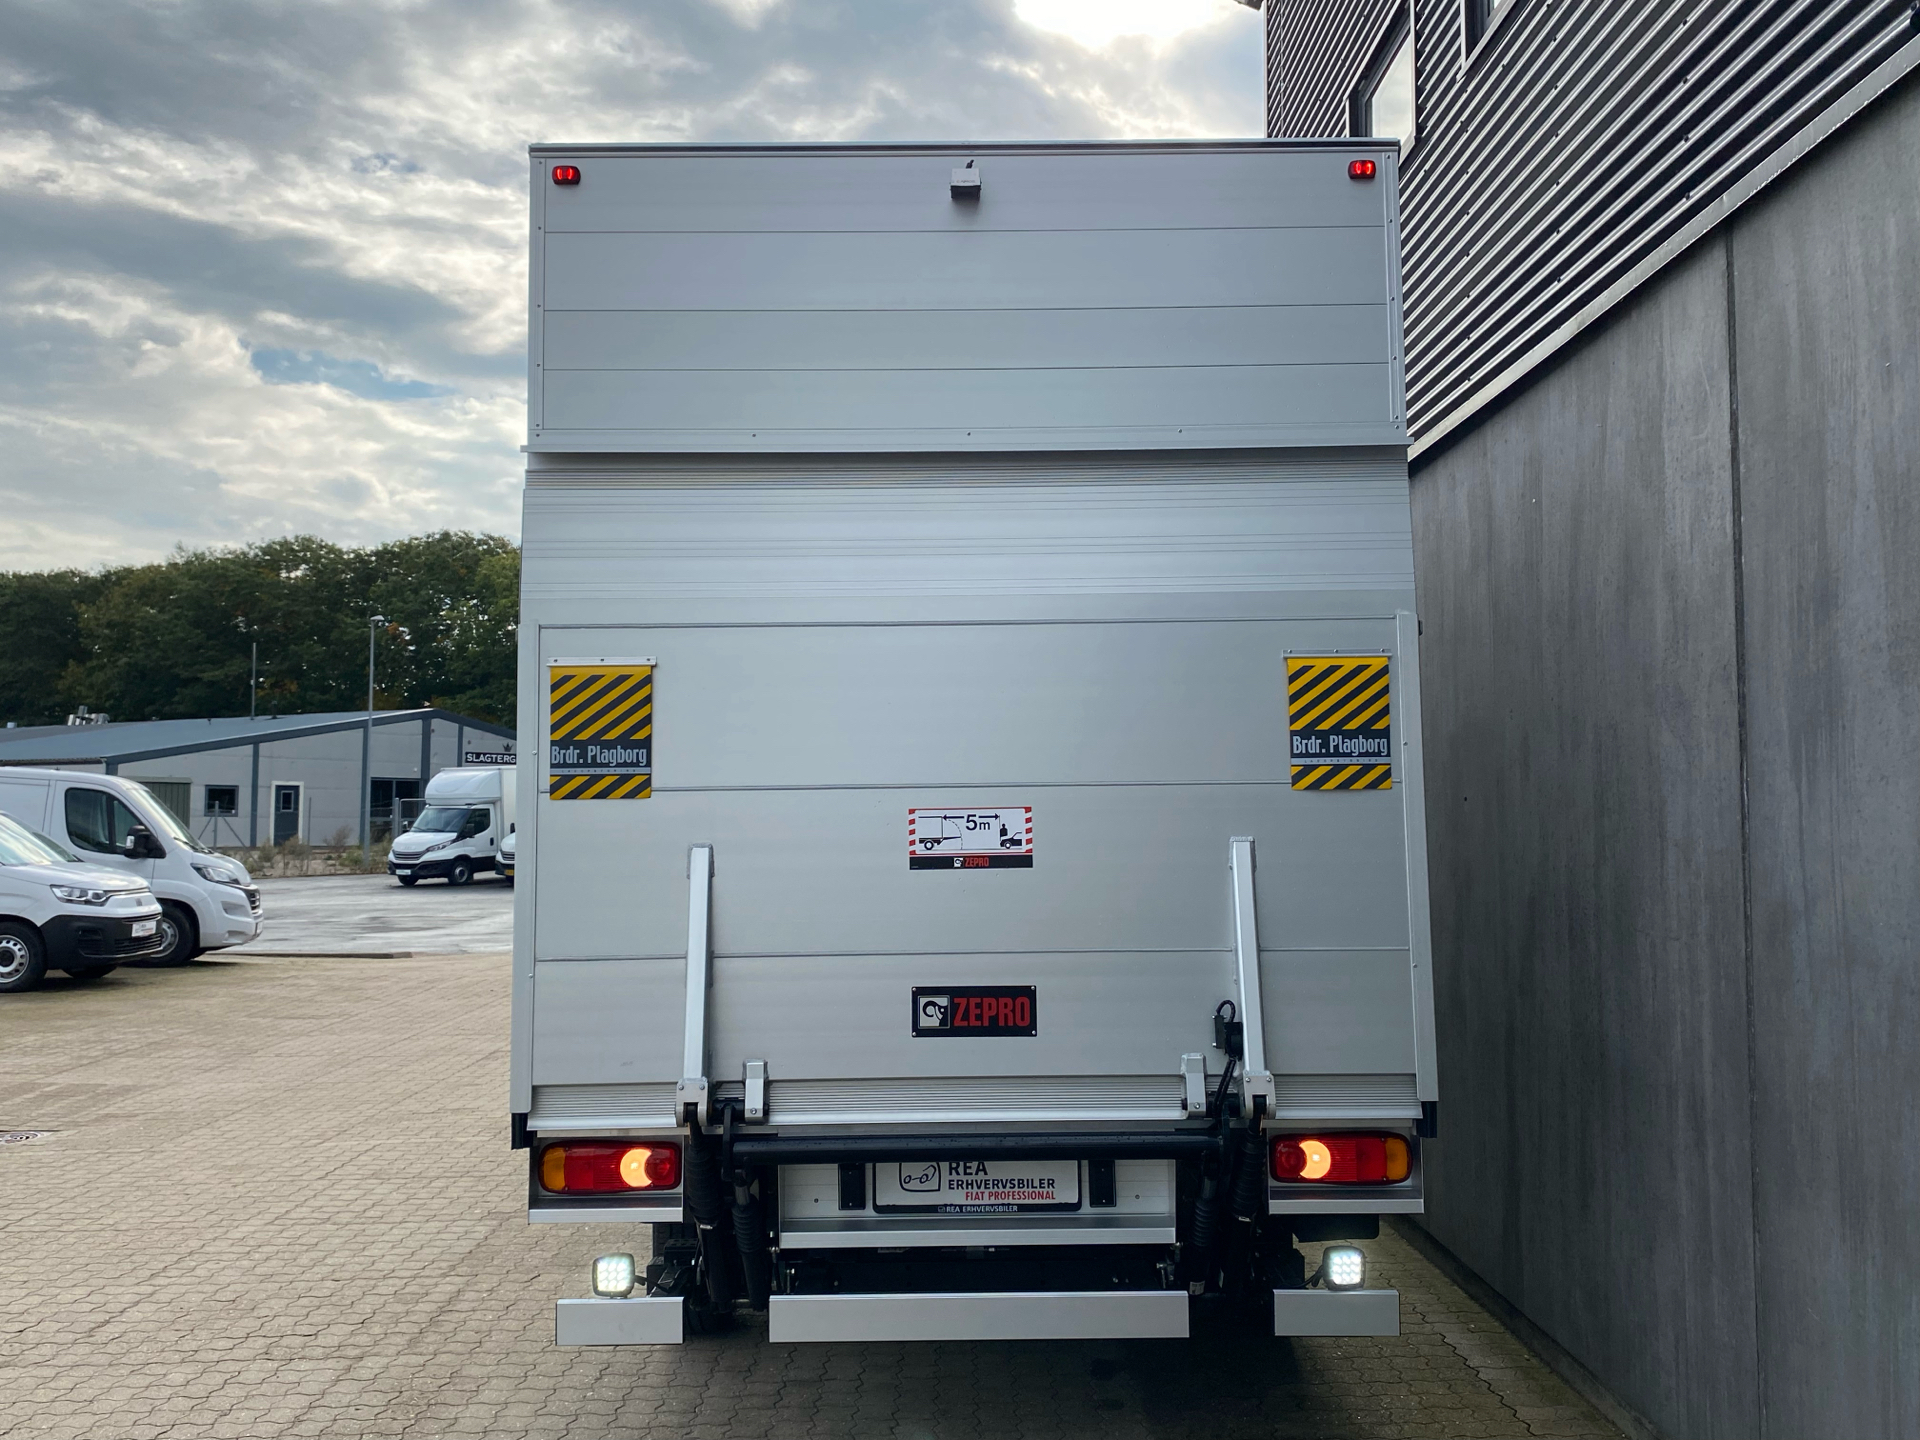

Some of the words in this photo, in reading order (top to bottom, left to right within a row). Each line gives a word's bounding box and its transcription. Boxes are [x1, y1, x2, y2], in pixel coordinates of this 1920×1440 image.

[1292, 735, 1327, 754] Brdr.
[1329, 734, 1388, 757] Plagborg
[551, 745, 584, 764] Brdr.
[587, 744, 648, 767] Plagborg
[964, 857, 989, 867] ZEPRO
[953, 996, 1031, 1027] ZEPRO
[948, 1161, 988, 1176] REA
[948, 1178, 1056, 1190] ERHVERVSBILER
[965, 1191, 985, 1201] FIAT
[988, 1190, 1056, 1201] PROFESSIONAL
